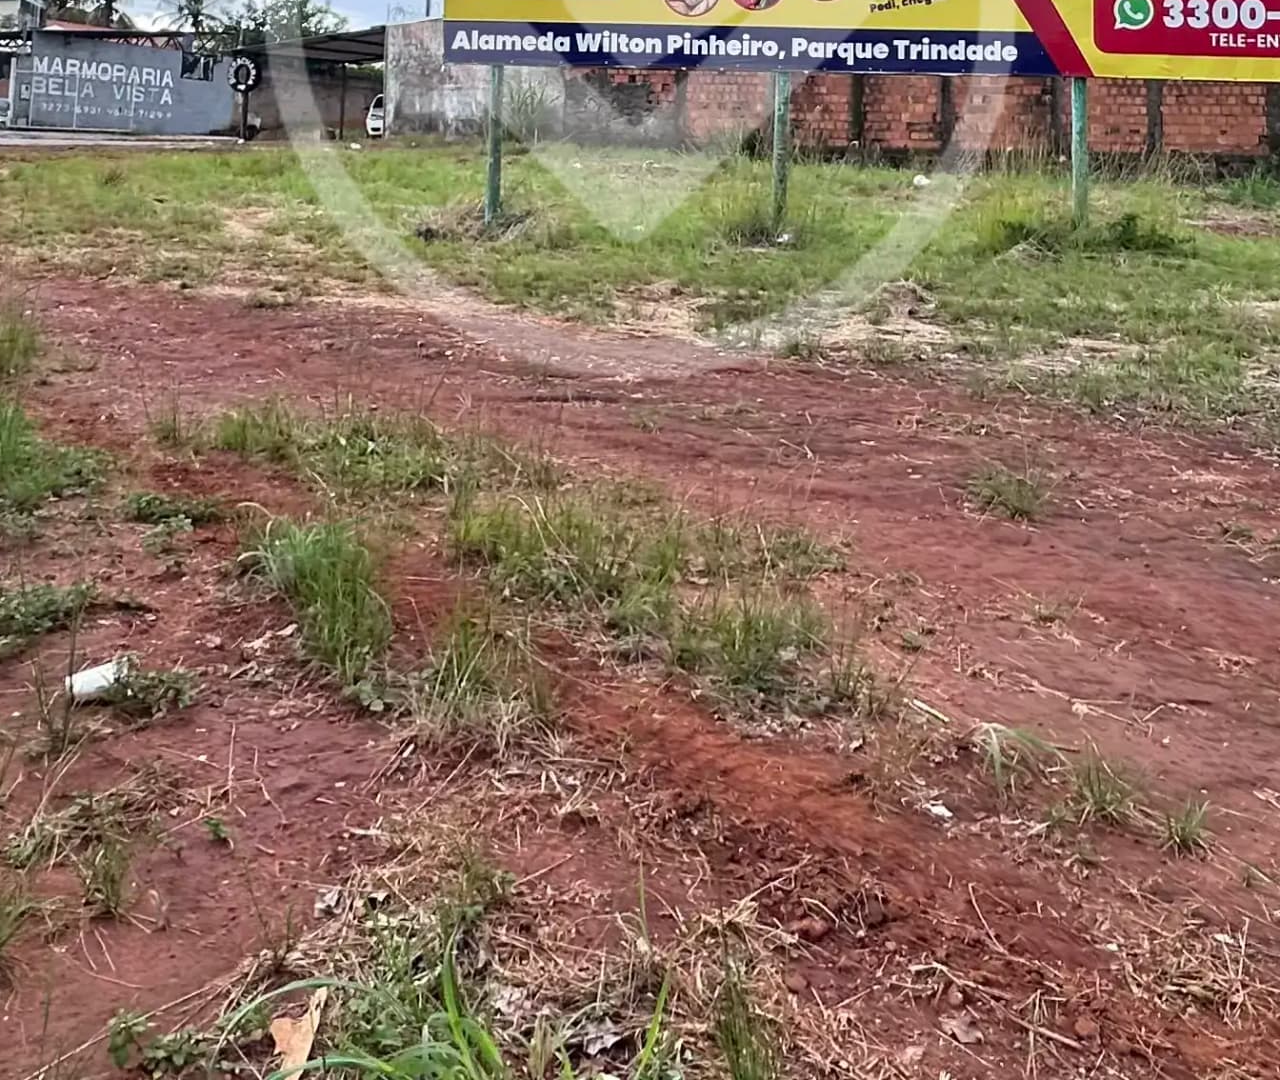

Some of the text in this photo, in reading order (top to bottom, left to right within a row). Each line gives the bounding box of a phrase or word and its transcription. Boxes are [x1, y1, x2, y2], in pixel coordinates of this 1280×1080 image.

[451, 30, 1018, 65] Alameda Wilton Pinheiro, Parque Trindade
[32, 55, 174, 87] MARMORARIA
[32, 76, 173, 105] BELA VISTA
